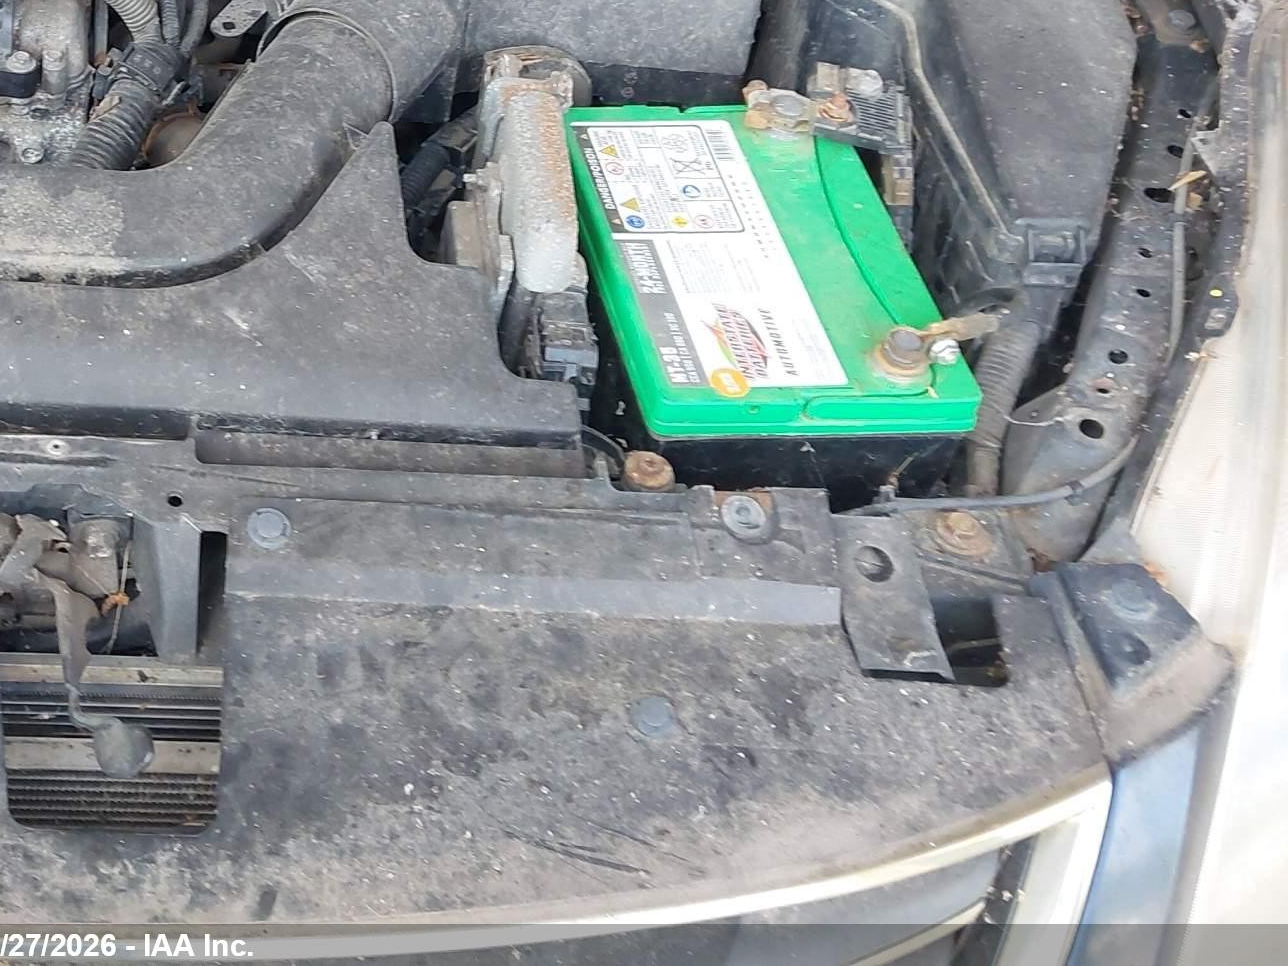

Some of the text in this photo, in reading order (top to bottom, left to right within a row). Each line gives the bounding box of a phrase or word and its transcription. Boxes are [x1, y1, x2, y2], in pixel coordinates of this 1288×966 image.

[583, 147, 617, 210] DANGER/POISON
[713, 303, 758, 380] INTERSTATE
[731, 310, 770, 379] BATTERIES
[757, 307, 799, 376] AUTOMOTIVE
